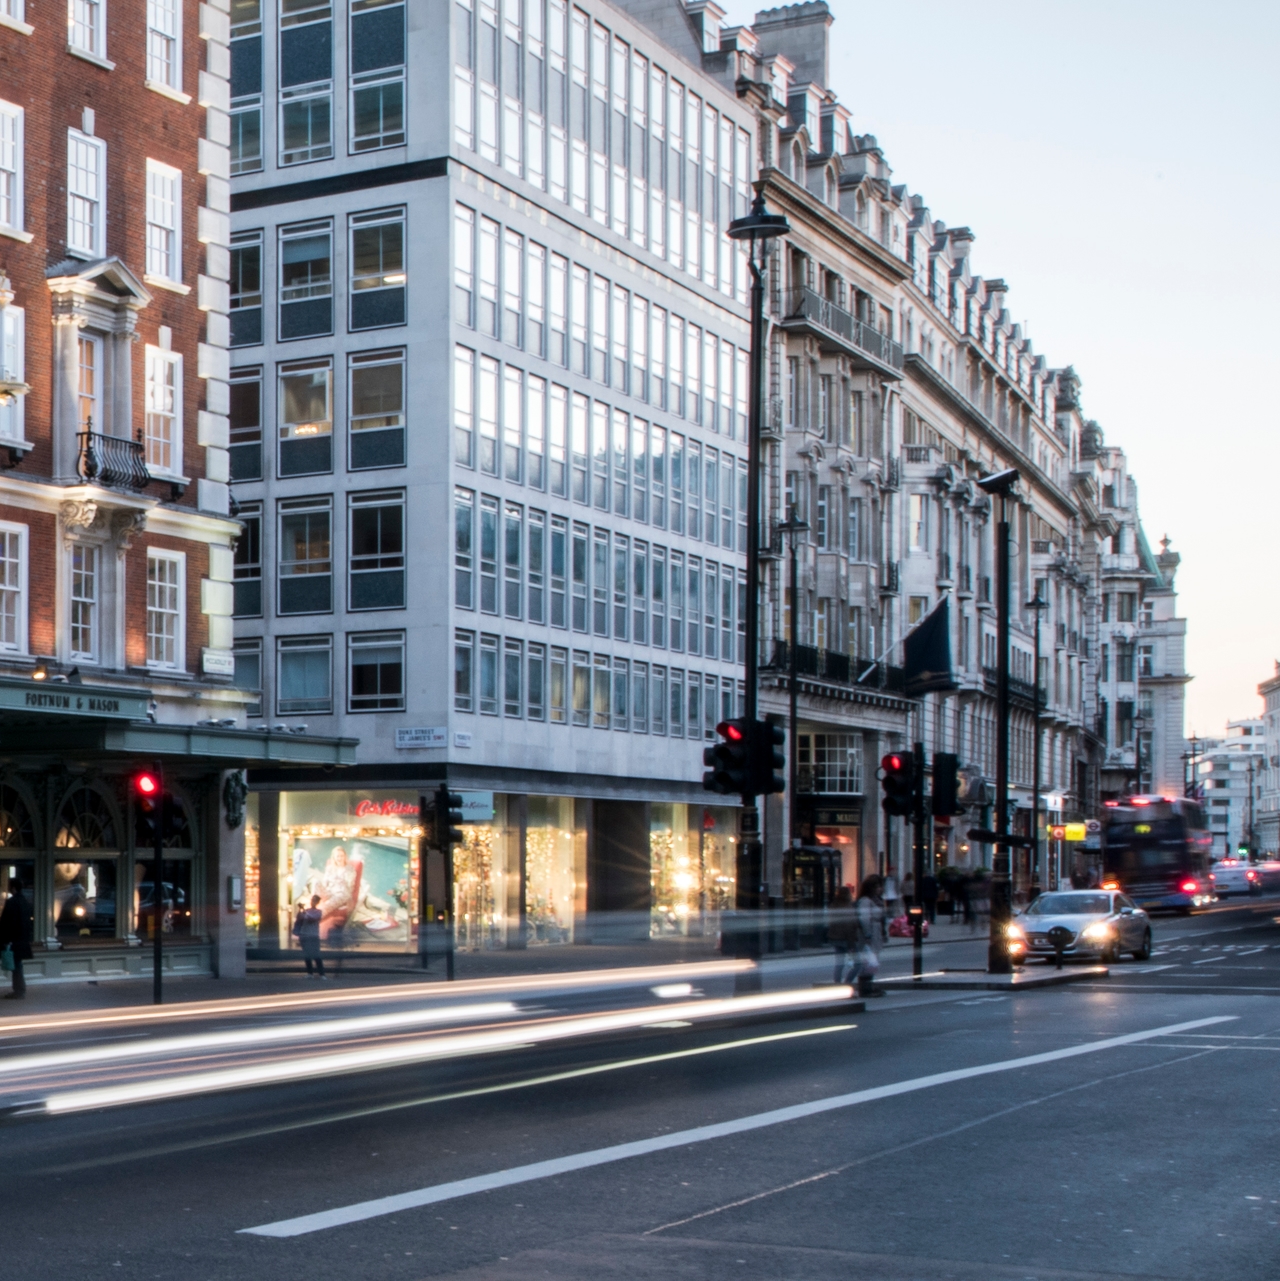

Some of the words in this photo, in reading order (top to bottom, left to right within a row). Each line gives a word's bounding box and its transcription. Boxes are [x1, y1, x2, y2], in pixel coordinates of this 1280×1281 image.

[25, 692, 70, 709] FORTNUM
[76, 697, 83, 709] &
[88, 698, 119, 712] MASON
[355, 799, 381, 817] Cath
[380, 799, 420, 816] Kidston
